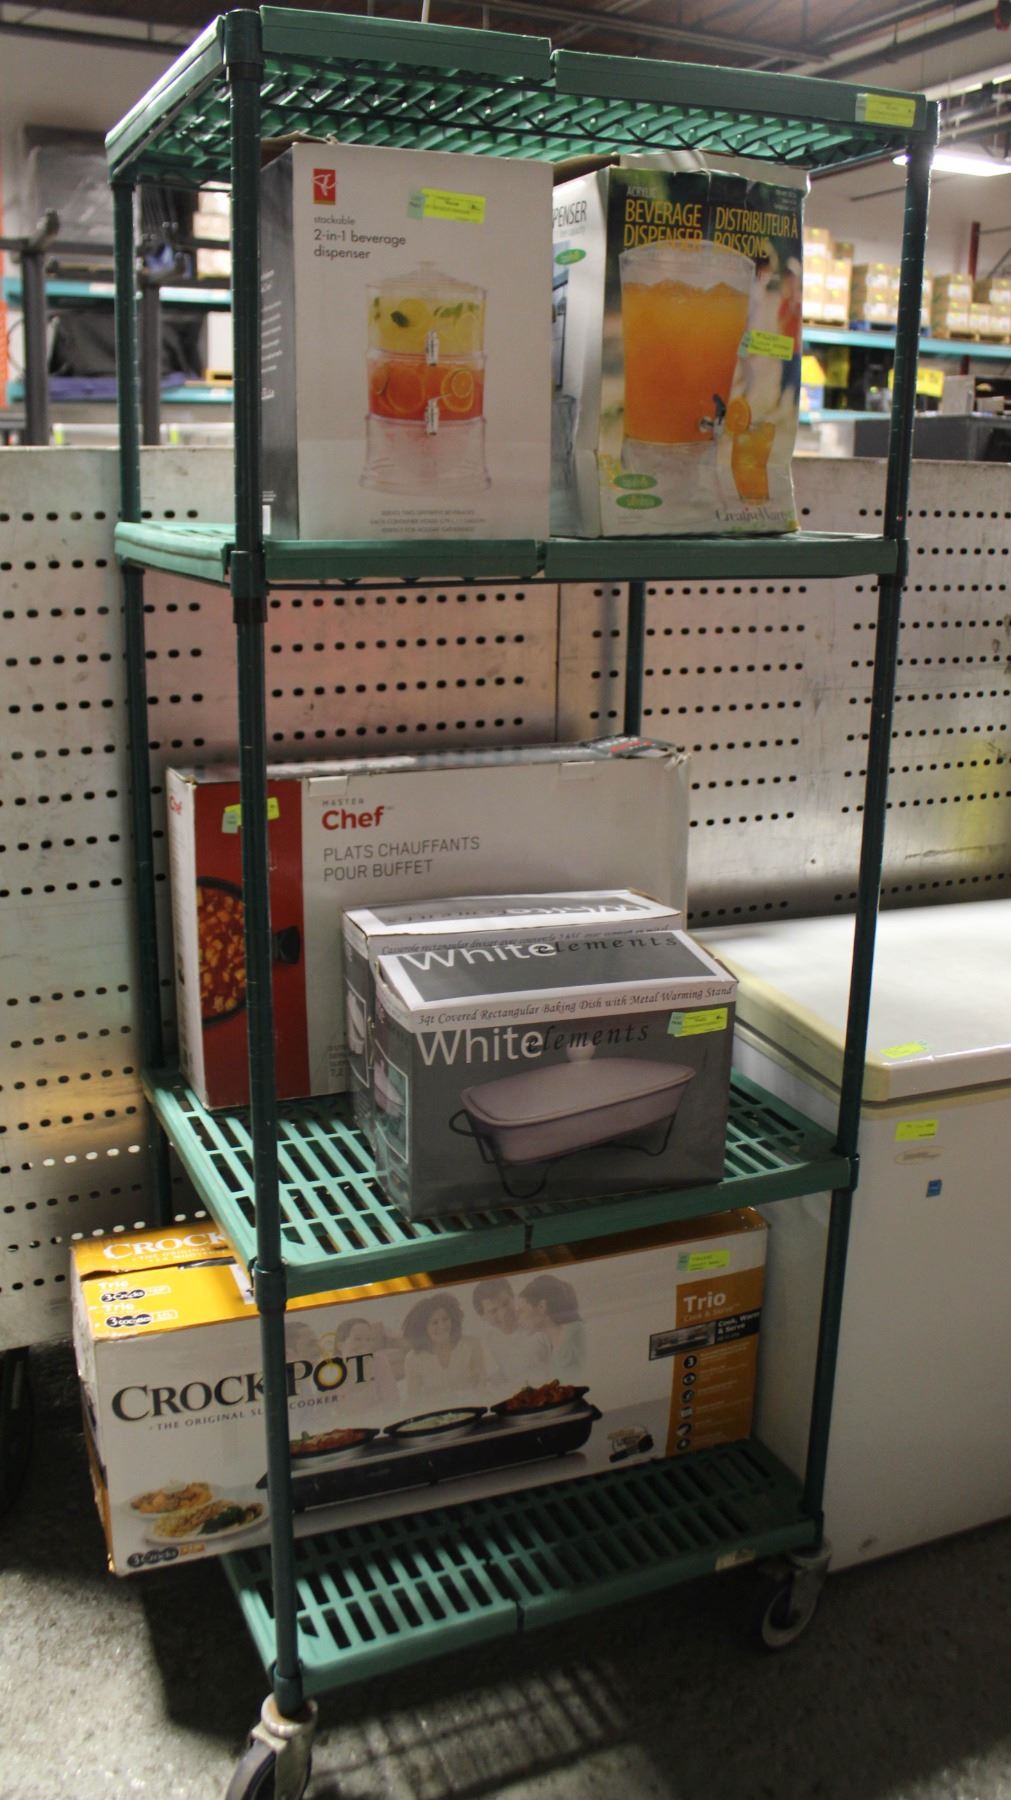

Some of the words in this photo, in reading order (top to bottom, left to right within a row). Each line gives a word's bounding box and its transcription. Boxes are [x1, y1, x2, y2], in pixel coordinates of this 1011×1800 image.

[314, 215, 356, 226] stackable
[625, 199, 702, 227] BEVERAGE
[715, 207, 789, 236] DISTRIBUTEUR
[791, 213, 799, 238] À
[314, 229, 346, 241] 2-in-1
[351, 230, 406, 247] beverage
[624, 225, 703, 250] DISPENSER
[714, 231, 769, 258] BOISSONS
[314, 245, 371, 260] dispenser
[322, 798, 364, 806] MASTER
[321, 805, 384, 831] Chef
[323, 844, 373, 862] PLATS
[378, 836, 480, 858] CHAUFFANTS
[324, 864, 367, 882] POUR
[372, 859, 433, 878] BUFFET
[401, 943, 557, 971] White
[418, 1014, 435, 1026] 3qt
[437, 1008, 477, 1024] Covered
[480, 1005, 540, 1020] Rectangular
[543, 1000, 576, 1013] Baking
[580, 999, 602, 1010] Dish
[605, 995, 627, 1008] with
[630, 992, 658, 1006] Metal
[661, 988, 703, 1003] Warming
[706, 984, 734, 998] Stand
[415, 1026, 545, 1067] White
[103, 1231, 226, 1260] CROCK
[683, 1291, 726, 1313] Trio
[111, 1372, 265, 1422] CROCK
[285, 1353, 374, 1397] POT
[157, 1422, 179, 1431] THE
[185, 1412, 244, 1426] ORIGINAL
[289, 1395, 338, 1410] COOKER
